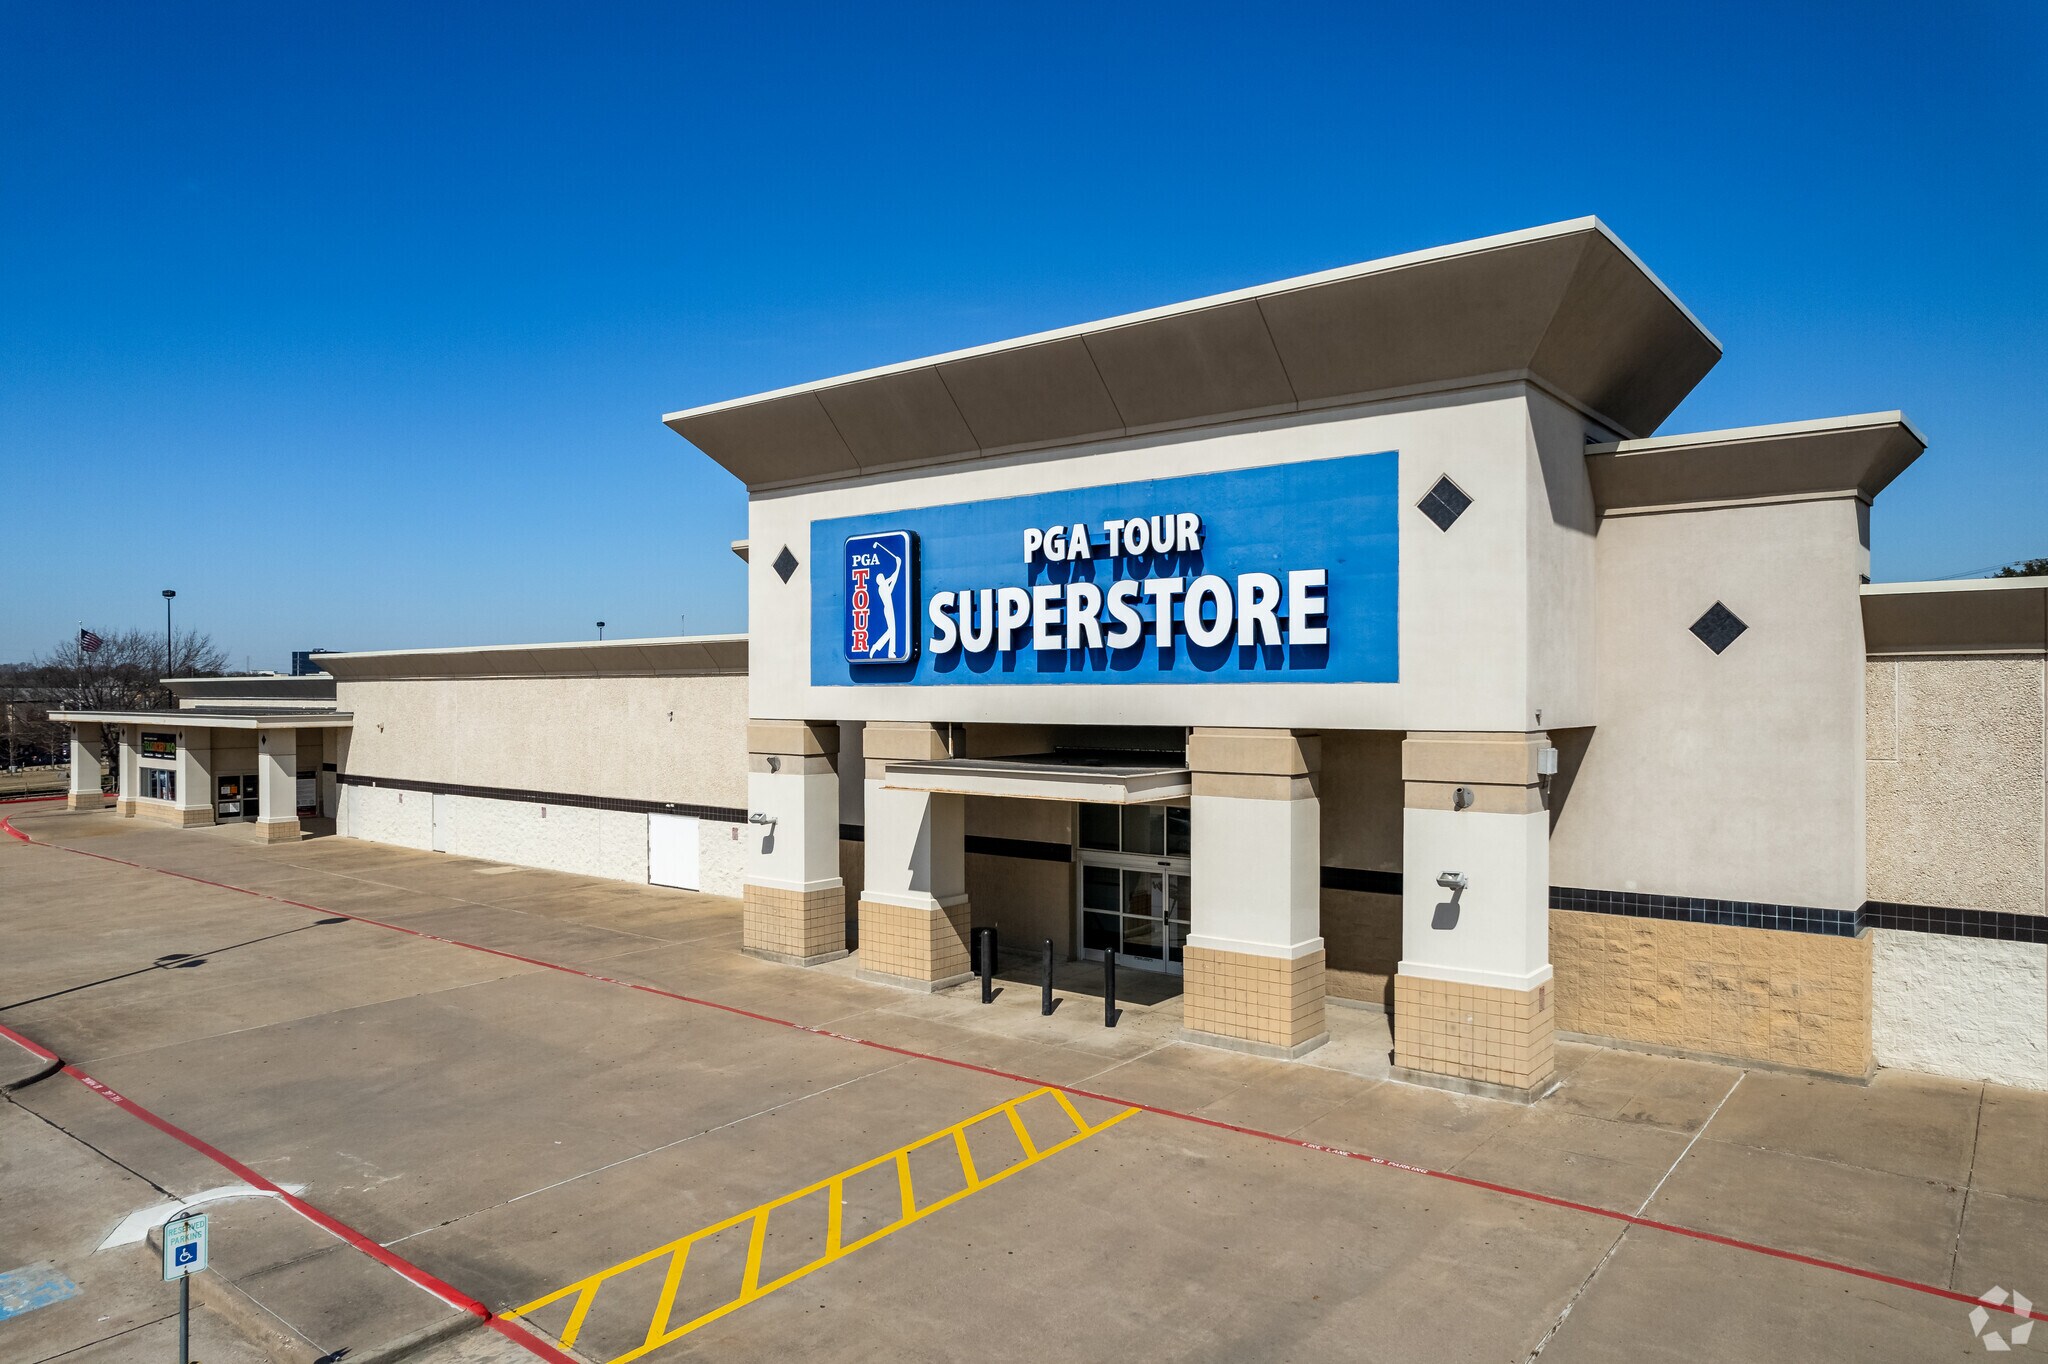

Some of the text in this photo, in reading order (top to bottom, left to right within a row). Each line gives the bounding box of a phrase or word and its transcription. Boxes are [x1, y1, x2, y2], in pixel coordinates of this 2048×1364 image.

[1023, 512, 1202, 564] PGA TOUR
[852, 554, 880, 567] PGA
[852, 568, 870, 652] TOUR
[928, 568, 1329, 654] SUPERSTORE
[1302, 1142, 1322, 1150] FIRE
[1325, 1147, 1351, 1157] LANE
[1387, 1160, 1430, 1174] PARKING
[169, 1220, 204, 1236] RESERVED
[170, 1231, 202, 1245] PARKING
